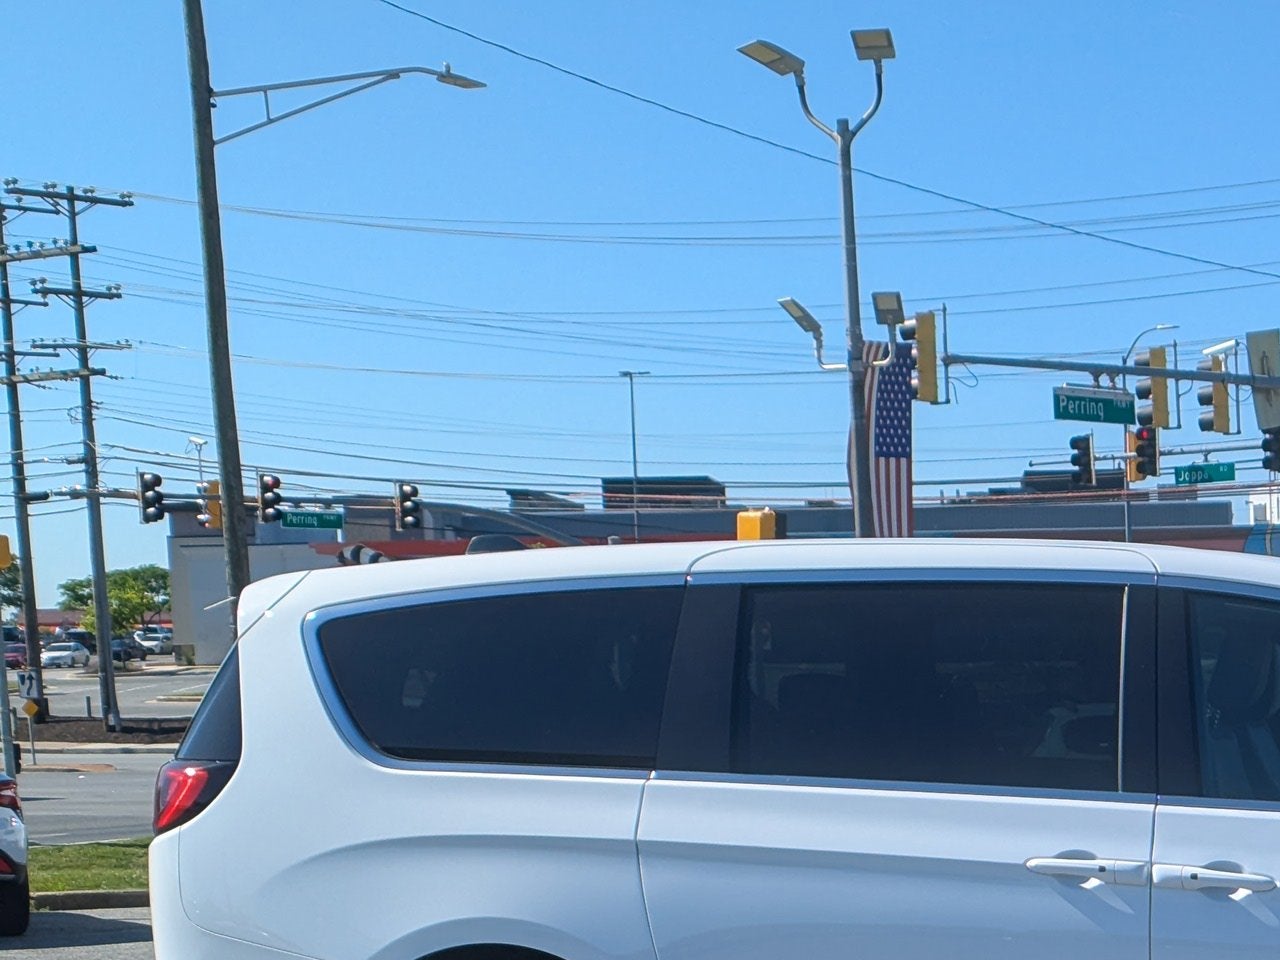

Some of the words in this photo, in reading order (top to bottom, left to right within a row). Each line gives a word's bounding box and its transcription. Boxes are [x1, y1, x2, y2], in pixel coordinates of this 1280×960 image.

[1060, 395, 1104, 421] Perring
[1178, 470, 1209, 482] Joppa
[286, 513, 318, 527] Perring
